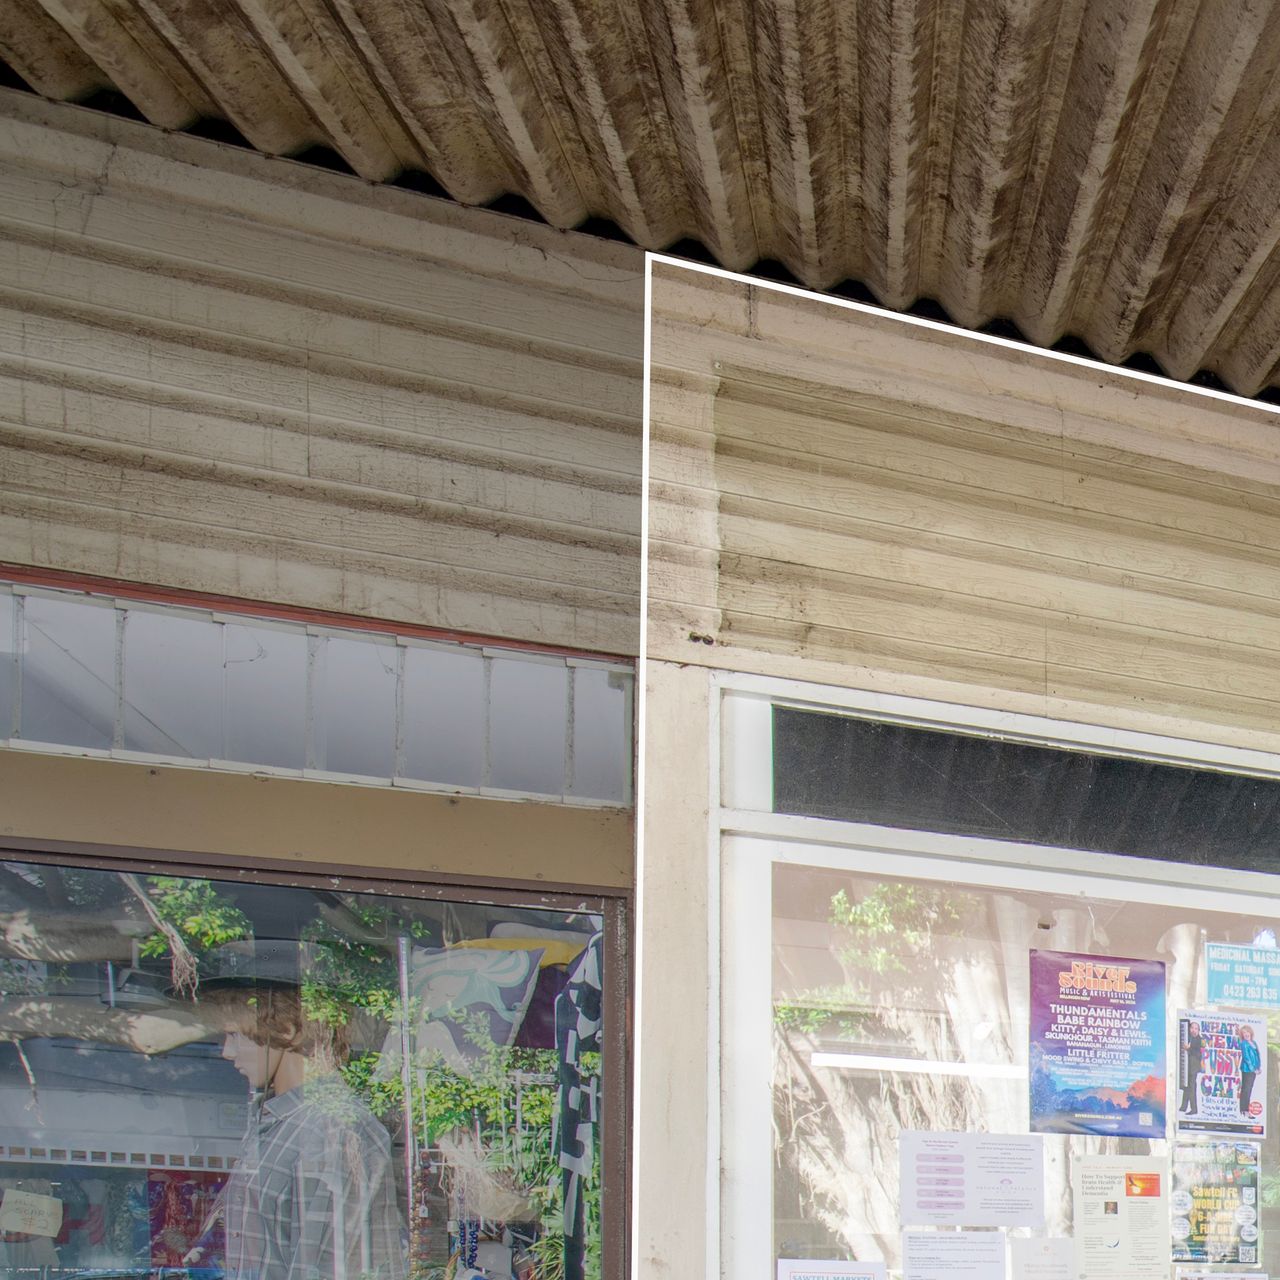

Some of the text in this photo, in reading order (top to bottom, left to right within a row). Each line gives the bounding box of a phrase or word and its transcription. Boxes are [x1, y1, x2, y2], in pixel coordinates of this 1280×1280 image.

[1209, 946, 1252, 961] MEDICINAL
[1071, 961, 1131, 979] River
[1058, 971, 1137, 993] Sounds
[1060, 987, 1080, 995] MUSIC
[1223, 984, 1245, 997] 0423
[1050, 1004, 1147, 1021] THUNDAMENTALS
[1057, 1015, 1141, 1029] BABE RAINBOW
[1082, 1026, 1108, 1036] DAISY
[1111, 1028, 1119, 1036] &
[1200, 1033, 1241, 1050] NEW
[1068, 1049, 1130, 1060] LITTLE FRITTER
[1200, 1048, 1243, 1075] PUSSY
